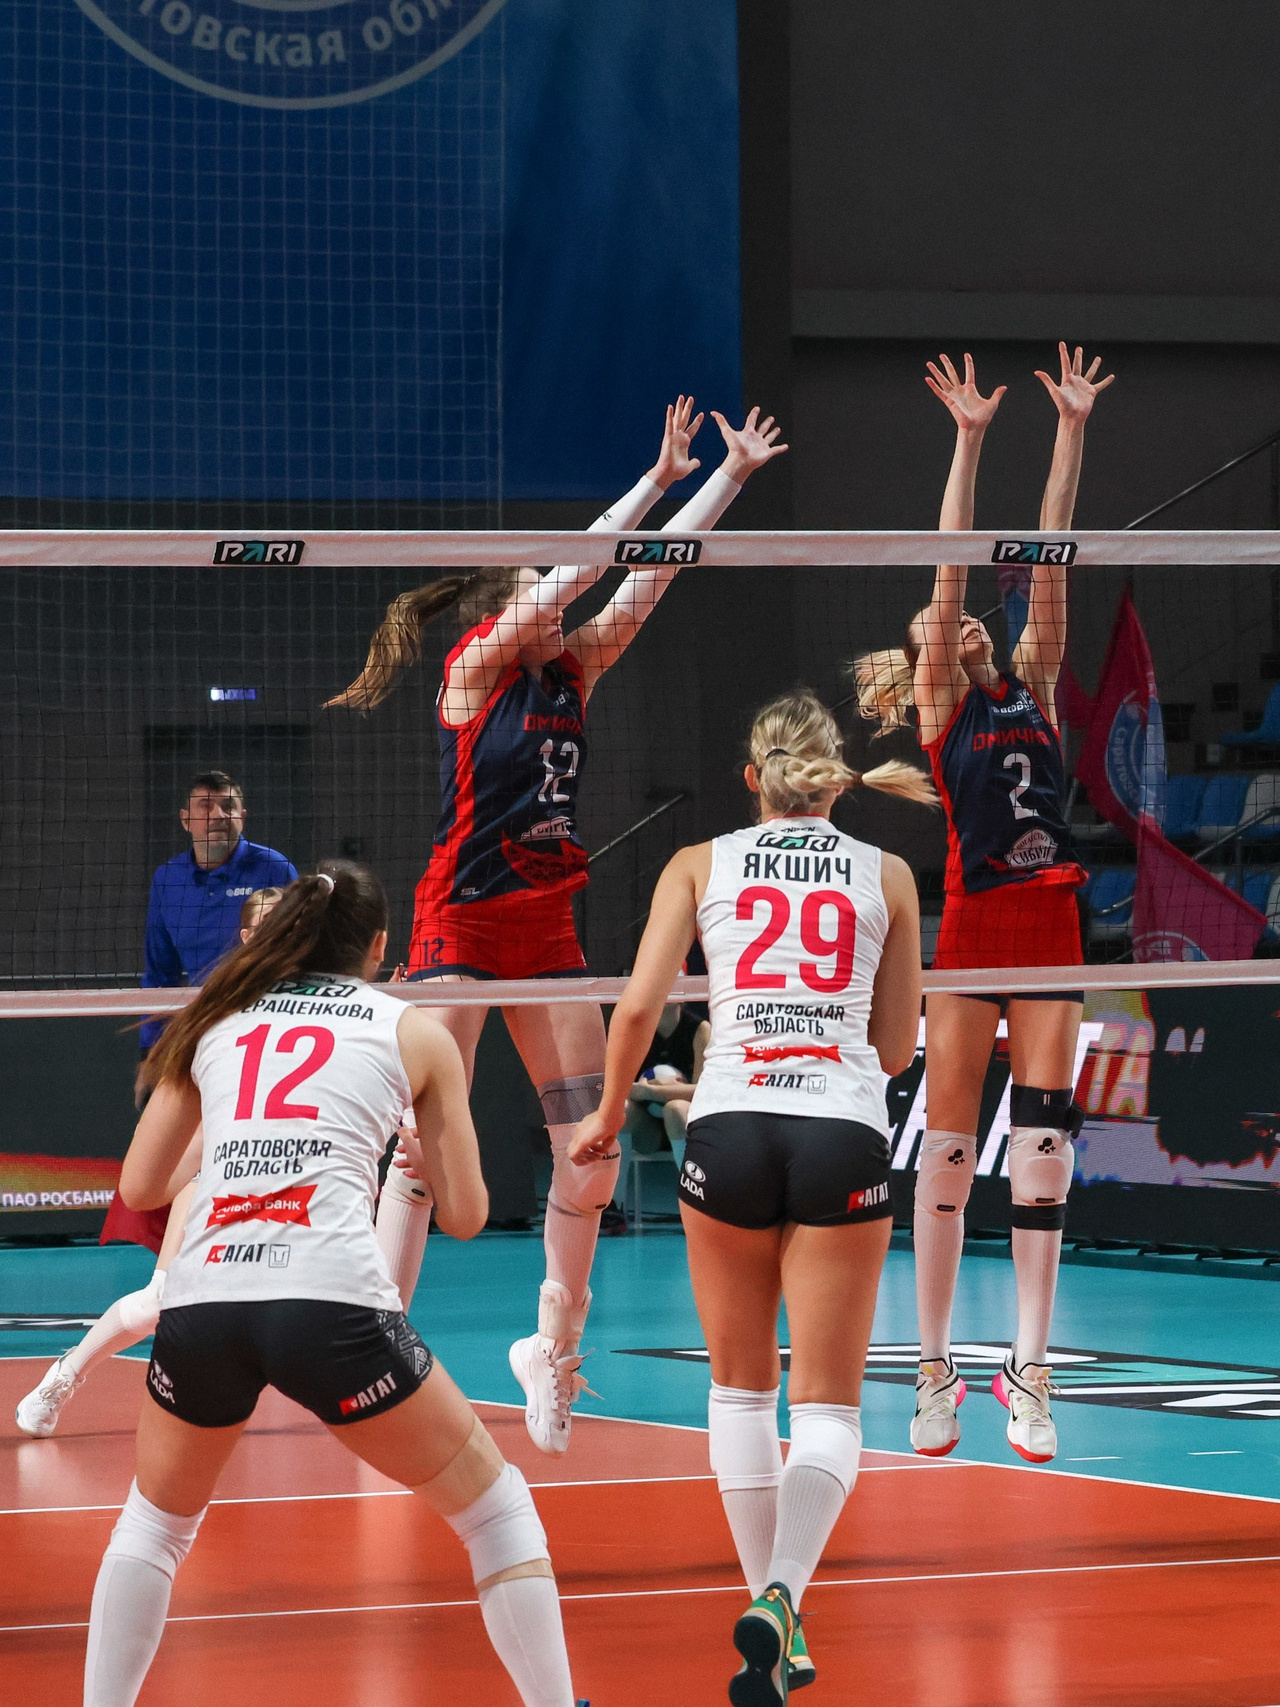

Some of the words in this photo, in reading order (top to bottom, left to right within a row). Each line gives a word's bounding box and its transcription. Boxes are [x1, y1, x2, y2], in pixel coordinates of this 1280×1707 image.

[219, 541, 298, 563] PARI
[620, 541, 695, 562] PARI
[998, 541, 1073, 563] PARI
[537, 738, 580, 803] 12
[1003, 752, 1040, 820] 2
[759, 833, 837, 851] PARI
[743, 852, 852, 886] ЯКШИЧ
[734, 885, 858, 994] 29
[424, 937, 444, 966] 12
[270, 981, 354, 998] PARI
[241, 999, 375, 1021] ЕРАЩЕНКОВА
[736, 1002, 846, 1021] САРАТОВСКАЯ
[753, 1016, 825, 1037] ОБЛАСТЬ
[233, 1023, 336, 1122] 12
[764, 1073, 806, 1089] АГАТ
[213, 1138, 333, 1165] САРАТОВСКАЯ
[223, 1157, 304, 1180] ОБЛАСТЬ
[2, 1192, 38, 1207] ПАО
[40, 1189, 117, 1206] РОСБАНК
[680, 1172, 705, 1201] LADA
[864, 1181, 890, 1207] АГАТ
[222, 1243, 267, 1263] АГАТ
[149, 1368, 175, 1404] LADA
[357, 1371, 399, 1409] АГАТ
